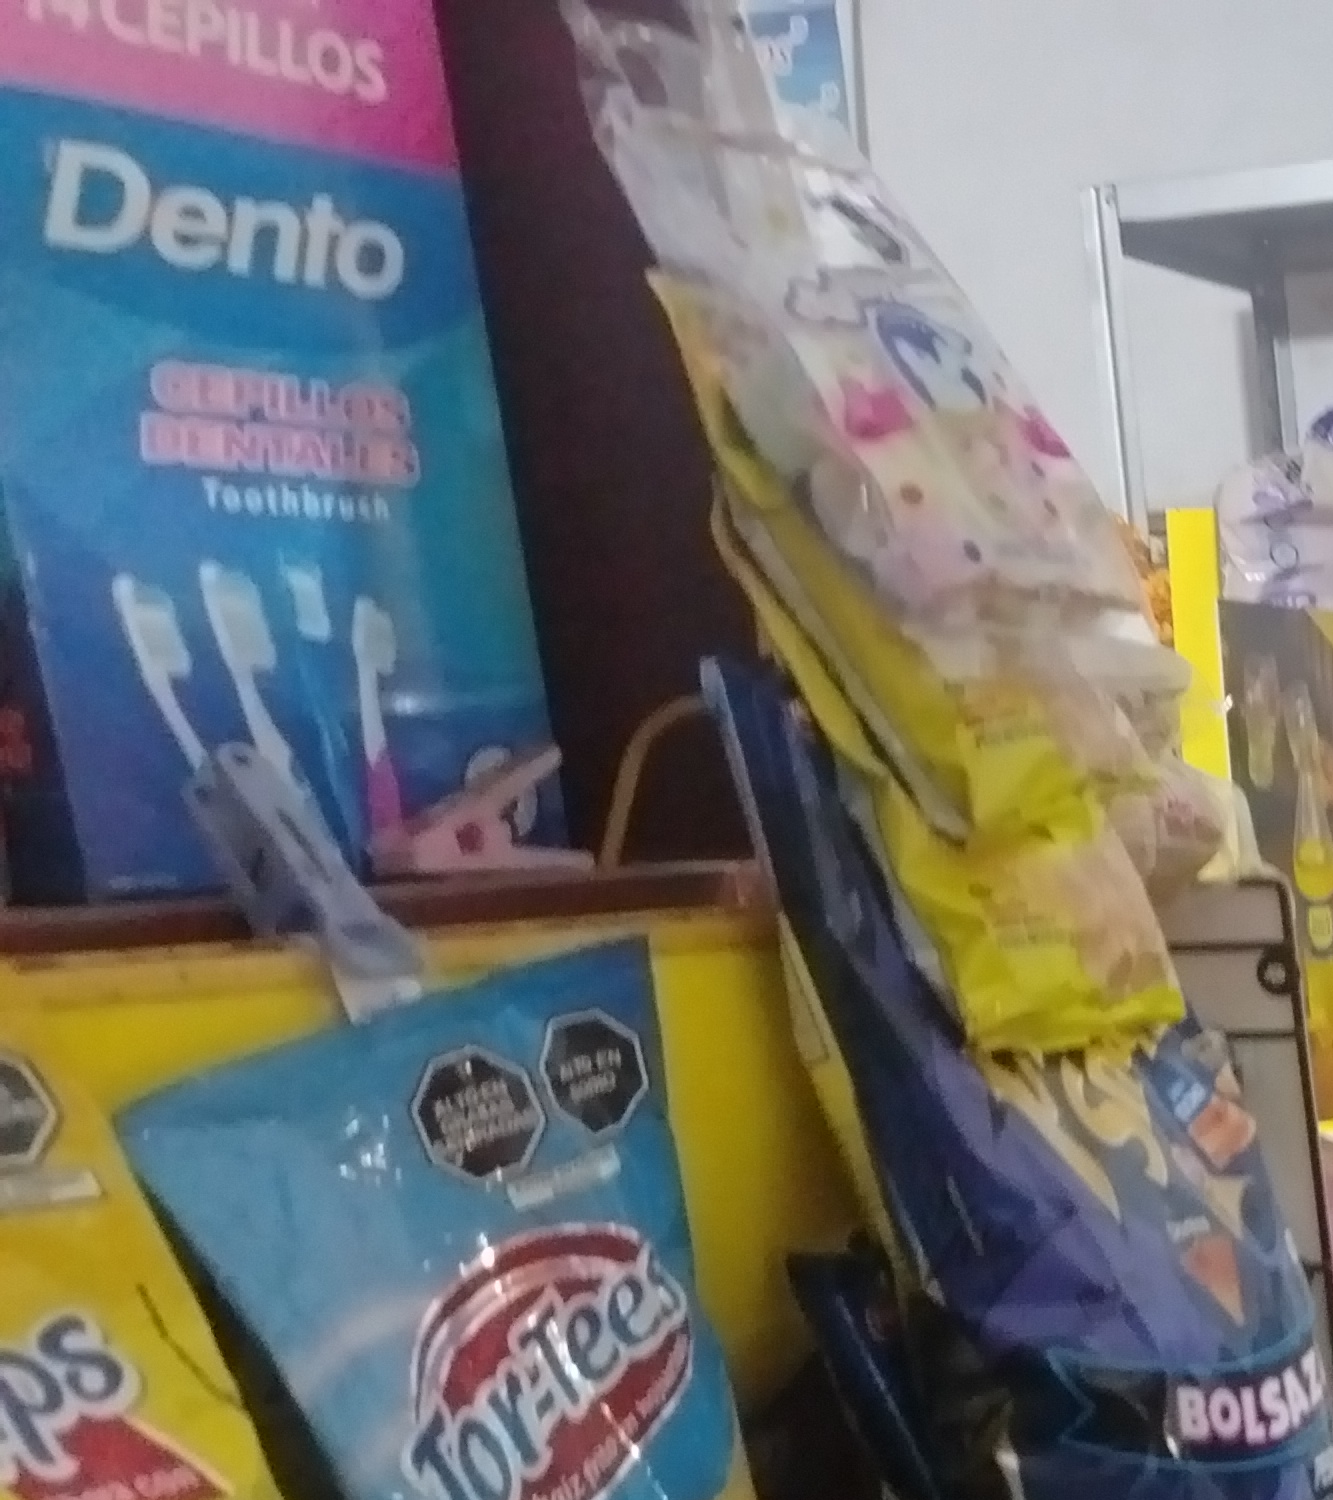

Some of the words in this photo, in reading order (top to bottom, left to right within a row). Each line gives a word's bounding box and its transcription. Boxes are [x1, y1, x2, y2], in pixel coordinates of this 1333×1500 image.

[99, 0, 389, 101] CEPILLOS
[44, 138, 405, 301] Dento
[0, 1312, 126, 1466] ps
